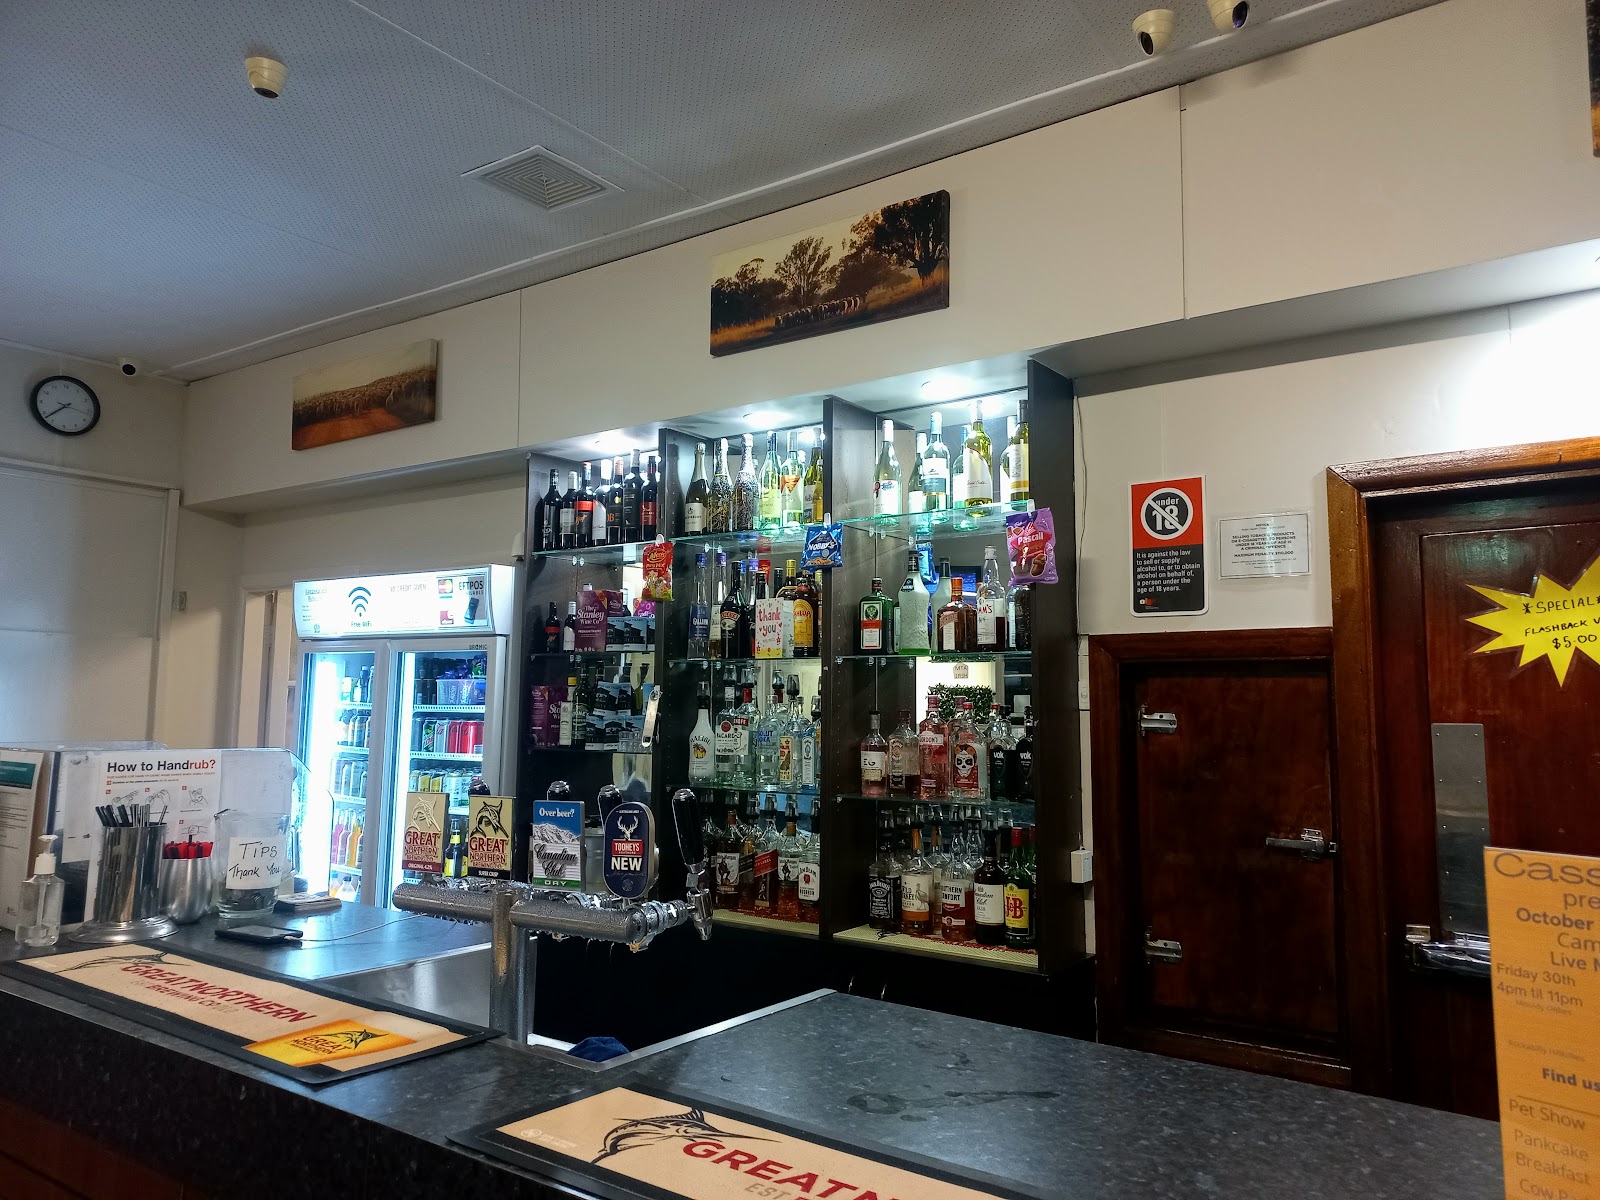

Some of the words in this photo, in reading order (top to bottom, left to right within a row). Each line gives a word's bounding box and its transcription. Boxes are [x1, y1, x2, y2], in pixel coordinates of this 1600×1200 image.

[1156, 497, 1180, 506] under
[1152, 506, 1179, 530] 18
[1018, 532, 1044, 545] Pascall
[1147, 551, 1168, 560] against
[1161, 556, 1180, 566] supply
[1182, 562, 1200, 570] obtain
[458, 580, 484, 590] EFTPOS
[1142, 580, 1162, 588] person
[1163, 585, 1180, 593] years.
[577, 608, 604, 622] Stanley
[758, 606, 780, 622] thank
[762, 625, 776, 637] you
[1524, 620, 1588, 636] FLASHBACK
[1020, 751, 1032, 759] vok
[107, 762, 137, 772] How
[141, 761, 153, 772] to
[158, 760, 216, 771] Handrub?
[539, 808, 556, 817] Over
[556, 808, 575, 818] beer?
[405, 831, 440, 846] GREAT
[470, 836, 508, 854] GREAT
[404, 844, 438, 857] NORTHERN
[534, 843, 578, 862] Canadian
[614, 842, 640, 852] TOOHEYS
[470, 852, 506, 864] NORTHERN
[611, 856, 642, 870] NEW
[228, 863, 260, 880] Thank
[266, 862, 280, 876] You
[542, 859, 566, 878] Club
[1516, 907, 1594, 931] October
[1550, 951, 1587, 970] Live
[1496, 963, 1539, 982] Friday
[1542, 971, 1576, 988] 30th
[1496, 982, 1528, 998] 4pm
[1530, 987, 1542, 999] til
[1548, 991, 1584, 1008] 11pm
[303, 1036, 352, 1051] GREAT
[1542, 1068, 1578, 1086] Find
[1509, 1099, 1535, 1117] Pet
[1540, 1106, 1586, 1131] Show
[1514, 1128, 1589, 1162] Pankcake
[1516, 1152, 1590, 1186] Breakfast
[1520, 1178, 1553, 1200] Cow
